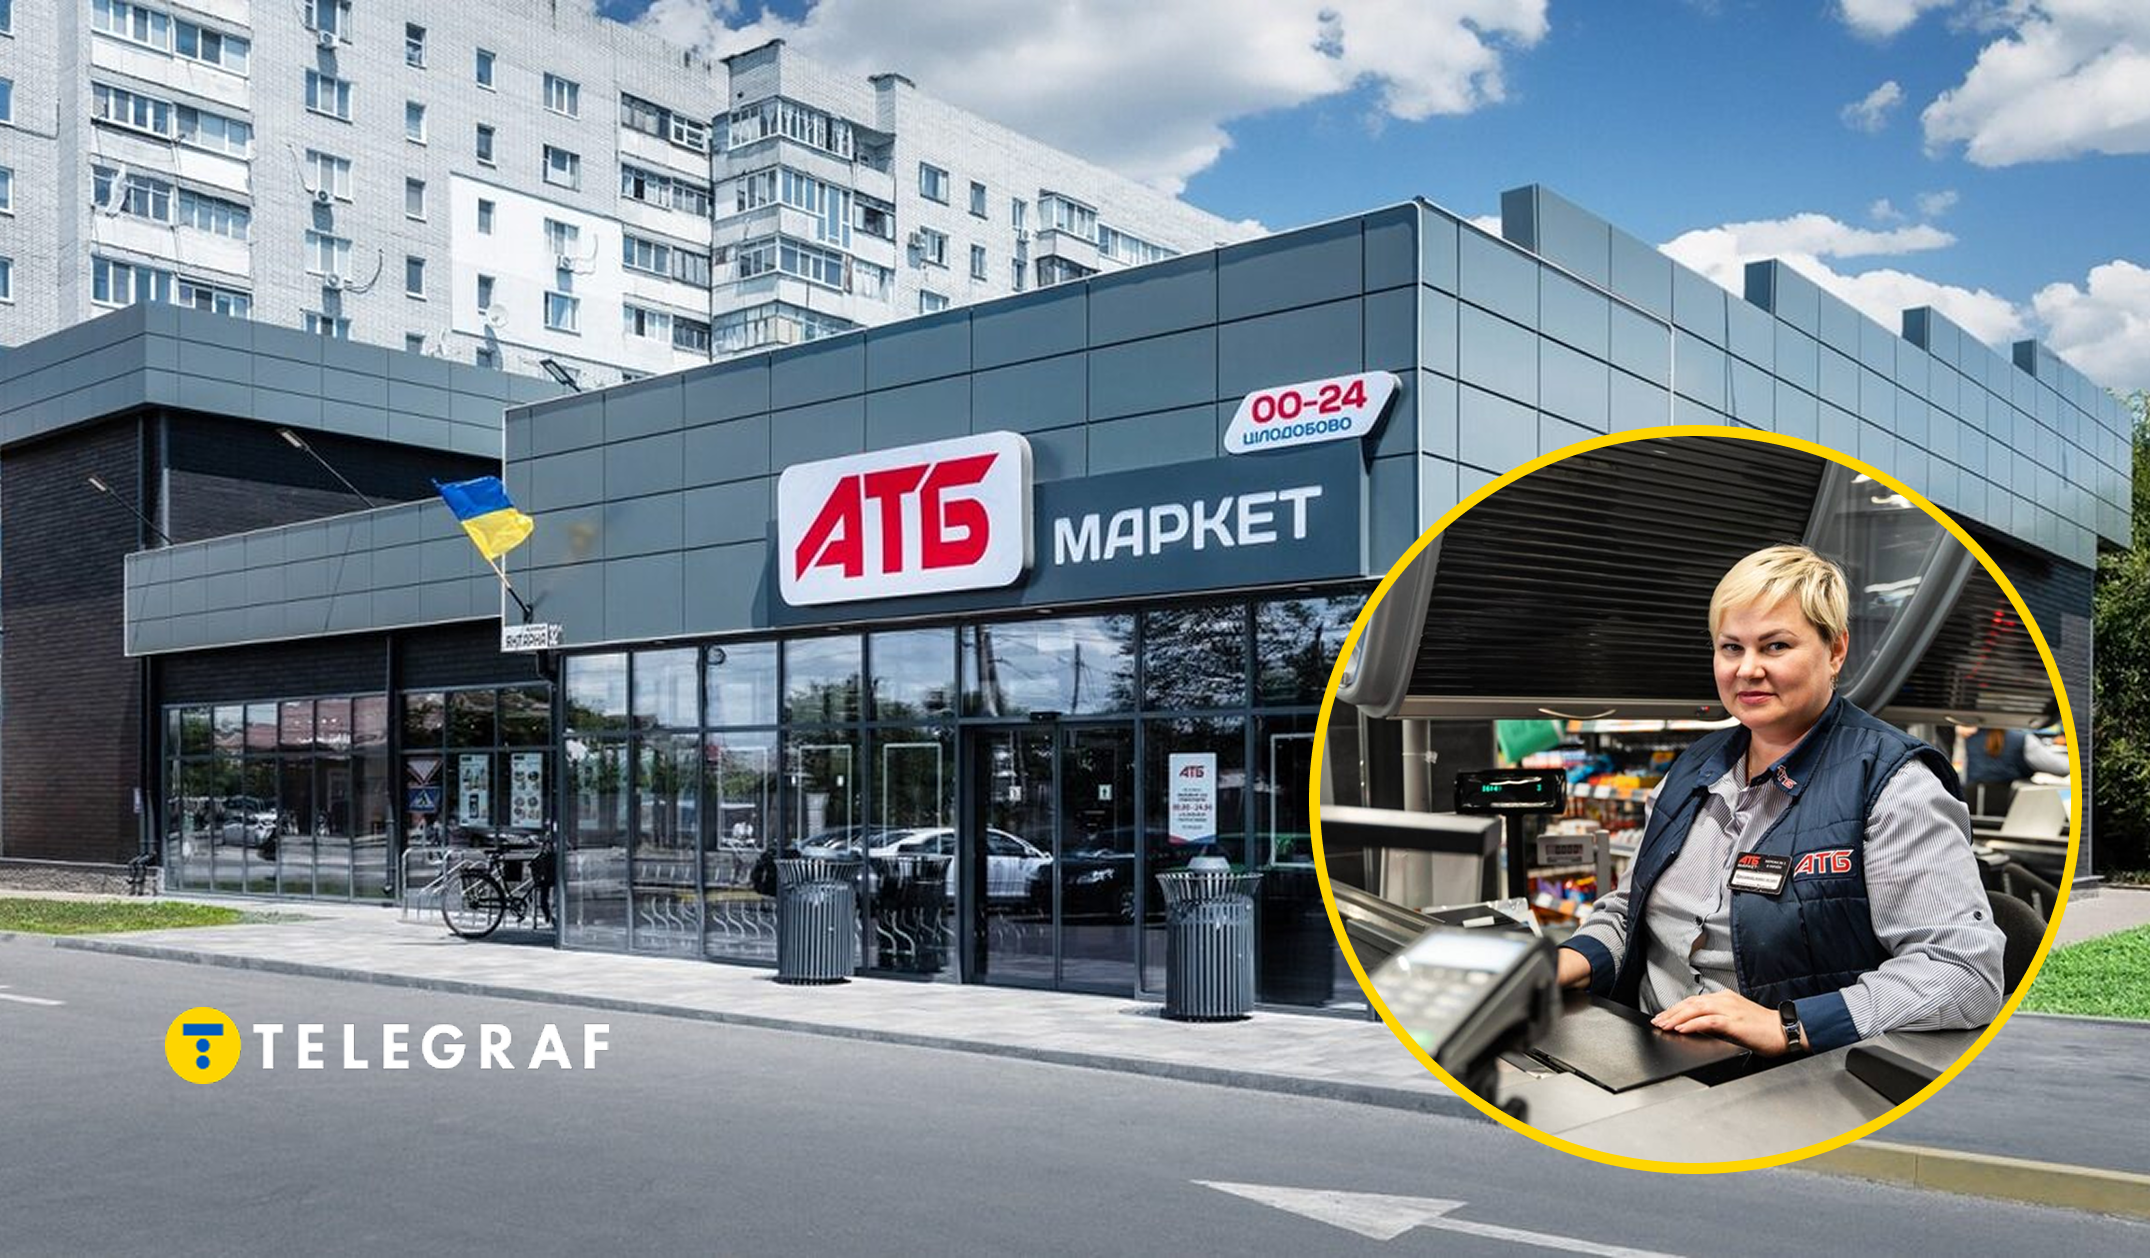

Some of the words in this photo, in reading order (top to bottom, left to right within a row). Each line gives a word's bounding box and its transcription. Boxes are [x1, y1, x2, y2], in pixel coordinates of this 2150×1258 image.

[1252, 380, 1367, 423] 00-24
[1243, 416, 1352, 445] ЦІЛОДОБОВО
[795, 453, 998, 582] АТБ
[1054, 486, 1322, 565] МАРКЕТ
[1179, 766, 1205, 778] АТБ
[1738, 854, 1761, 866] АТБ
[1794, 850, 1853, 876] АТБ
